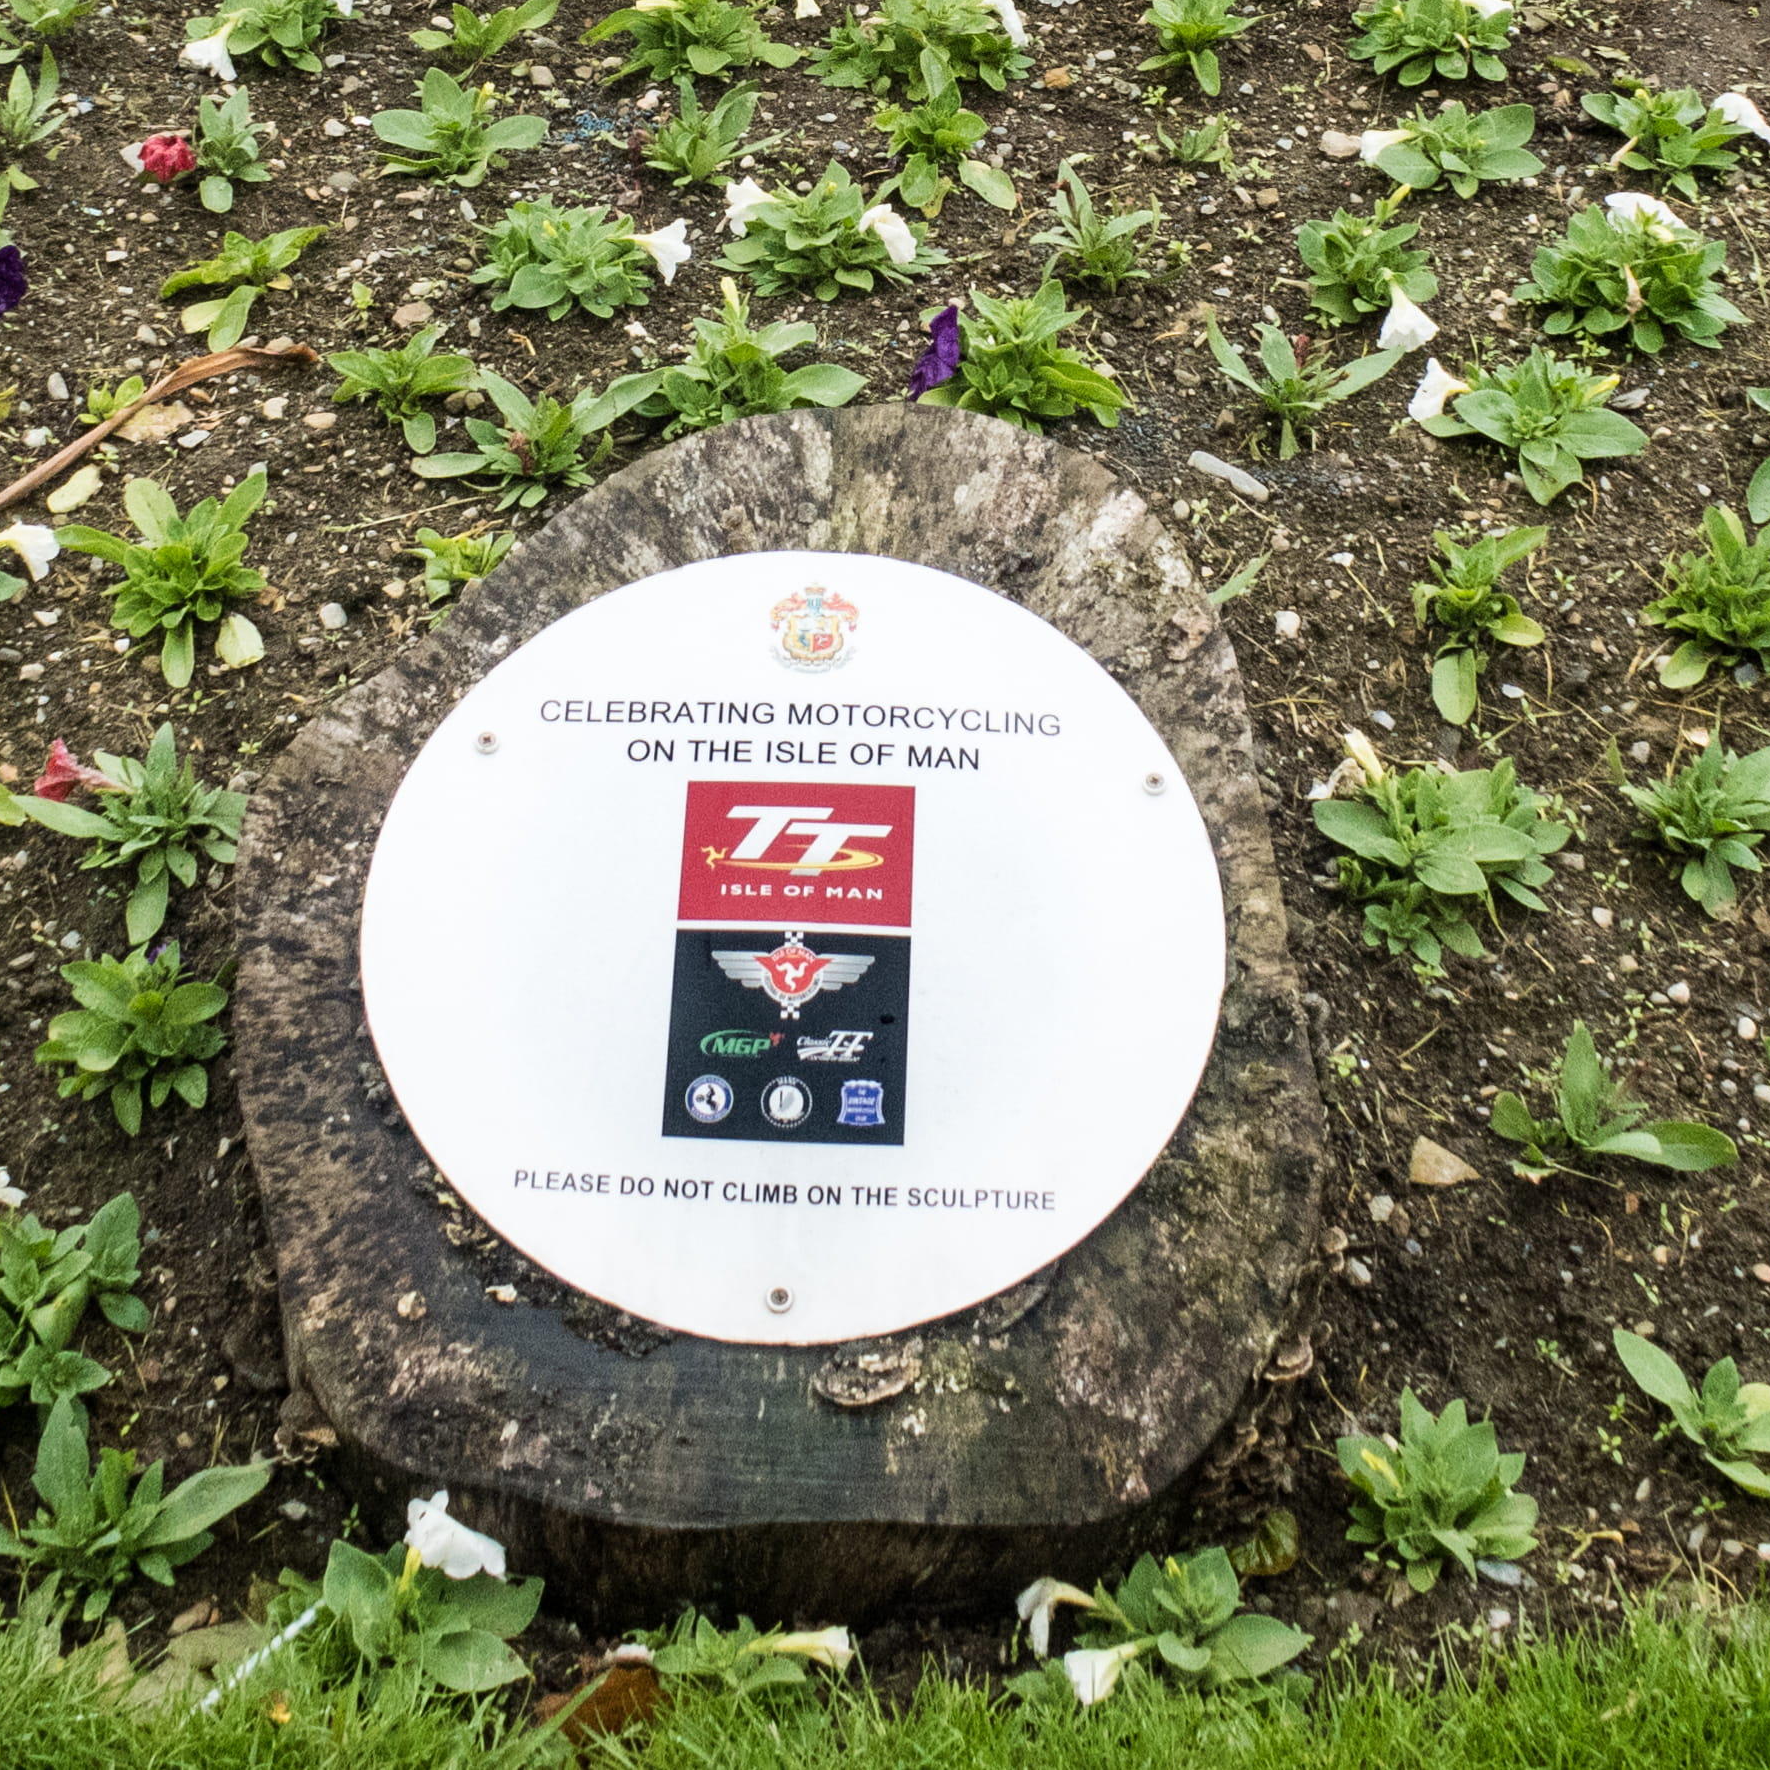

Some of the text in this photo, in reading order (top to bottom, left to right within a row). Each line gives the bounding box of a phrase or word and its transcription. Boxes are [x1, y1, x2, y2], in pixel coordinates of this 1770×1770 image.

[540, 700, 1061, 737] CELEBRATING MOTORCYCLING
[626, 738, 980, 771] ON THE ISLE OF MAN
[726, 805, 894, 877] TT
[719, 883, 884, 901] ISLE OF MAN
[712, 1037, 772, 1055] MGP
[514, 1169, 1056, 1210] PLEASE DO NOT CLIMB ON THE SCULPTURE
